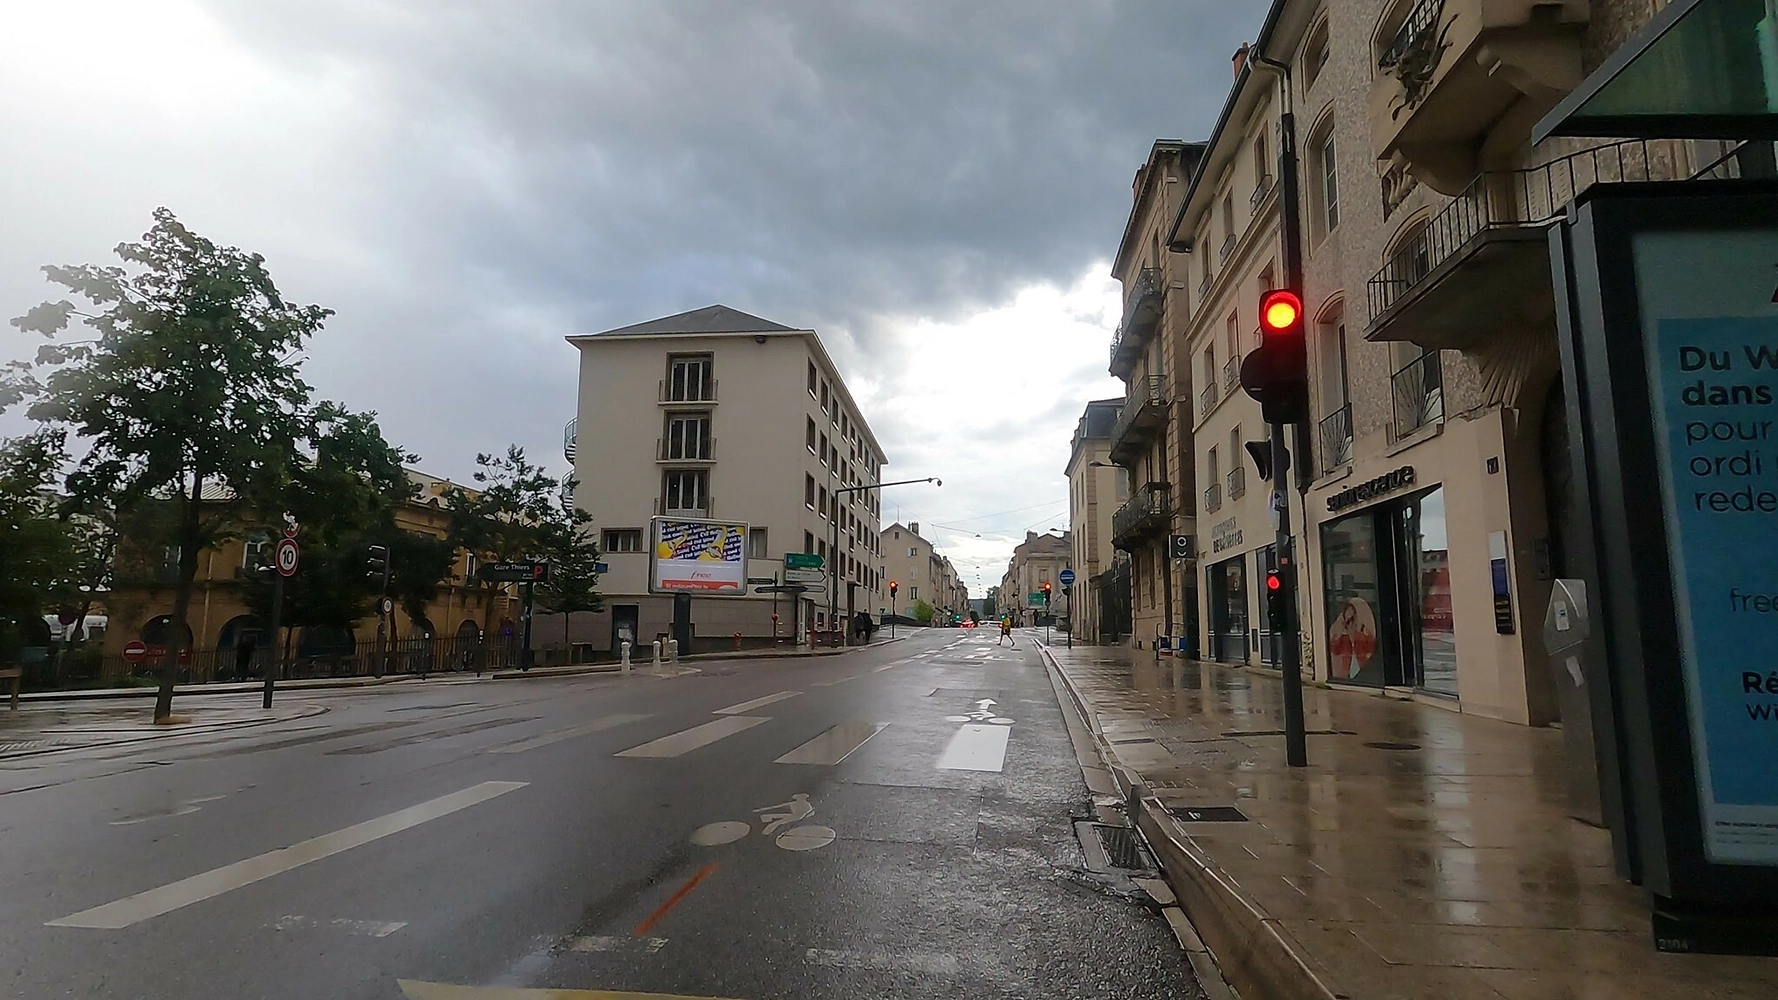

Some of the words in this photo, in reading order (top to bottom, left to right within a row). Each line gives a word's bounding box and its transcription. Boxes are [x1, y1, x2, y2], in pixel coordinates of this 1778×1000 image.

[1679, 346, 1731, 371] Du
[1682, 379, 1773, 406] dans
[1686, 420, 1773, 446] pour
[1689, 449, 1762, 476] ordi
[282, 549, 294, 565] 10
[690, 570, 712, 579] free
